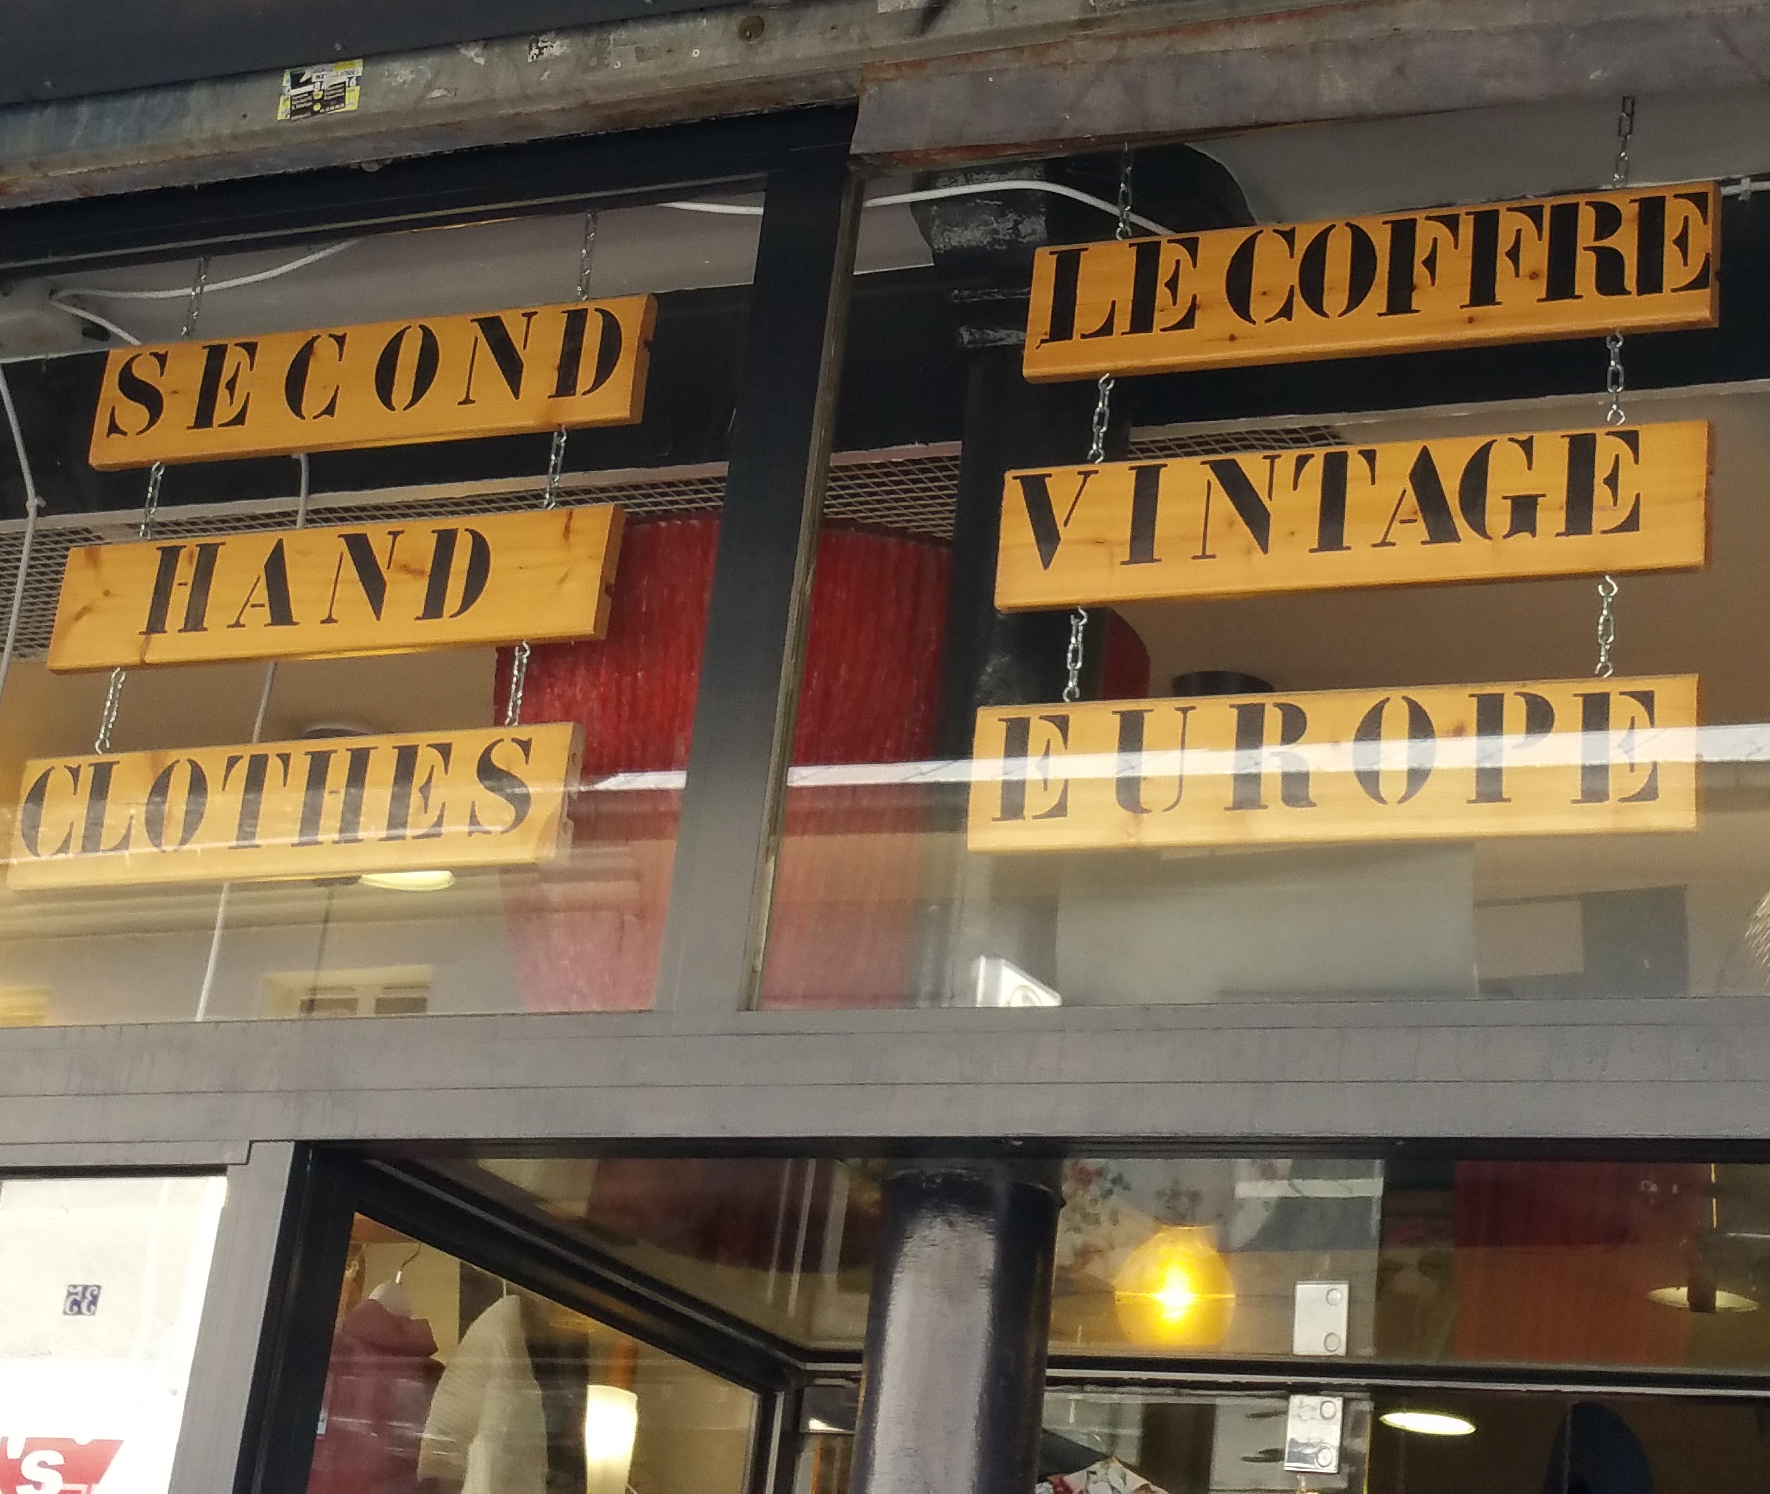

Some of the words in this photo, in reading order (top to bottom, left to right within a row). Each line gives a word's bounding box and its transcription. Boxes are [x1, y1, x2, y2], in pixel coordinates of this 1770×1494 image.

[1036, 236, 1201, 350] LE
[1225, 191, 1711, 328] COFFRE
[105, 306, 623, 439] SECOND
[1013, 428, 1642, 572] VINTAGE
[138, 527, 492, 637] HAND
[20, 736, 534, 860] CLOTHES
[991, 689, 1660, 824] EUROPE
